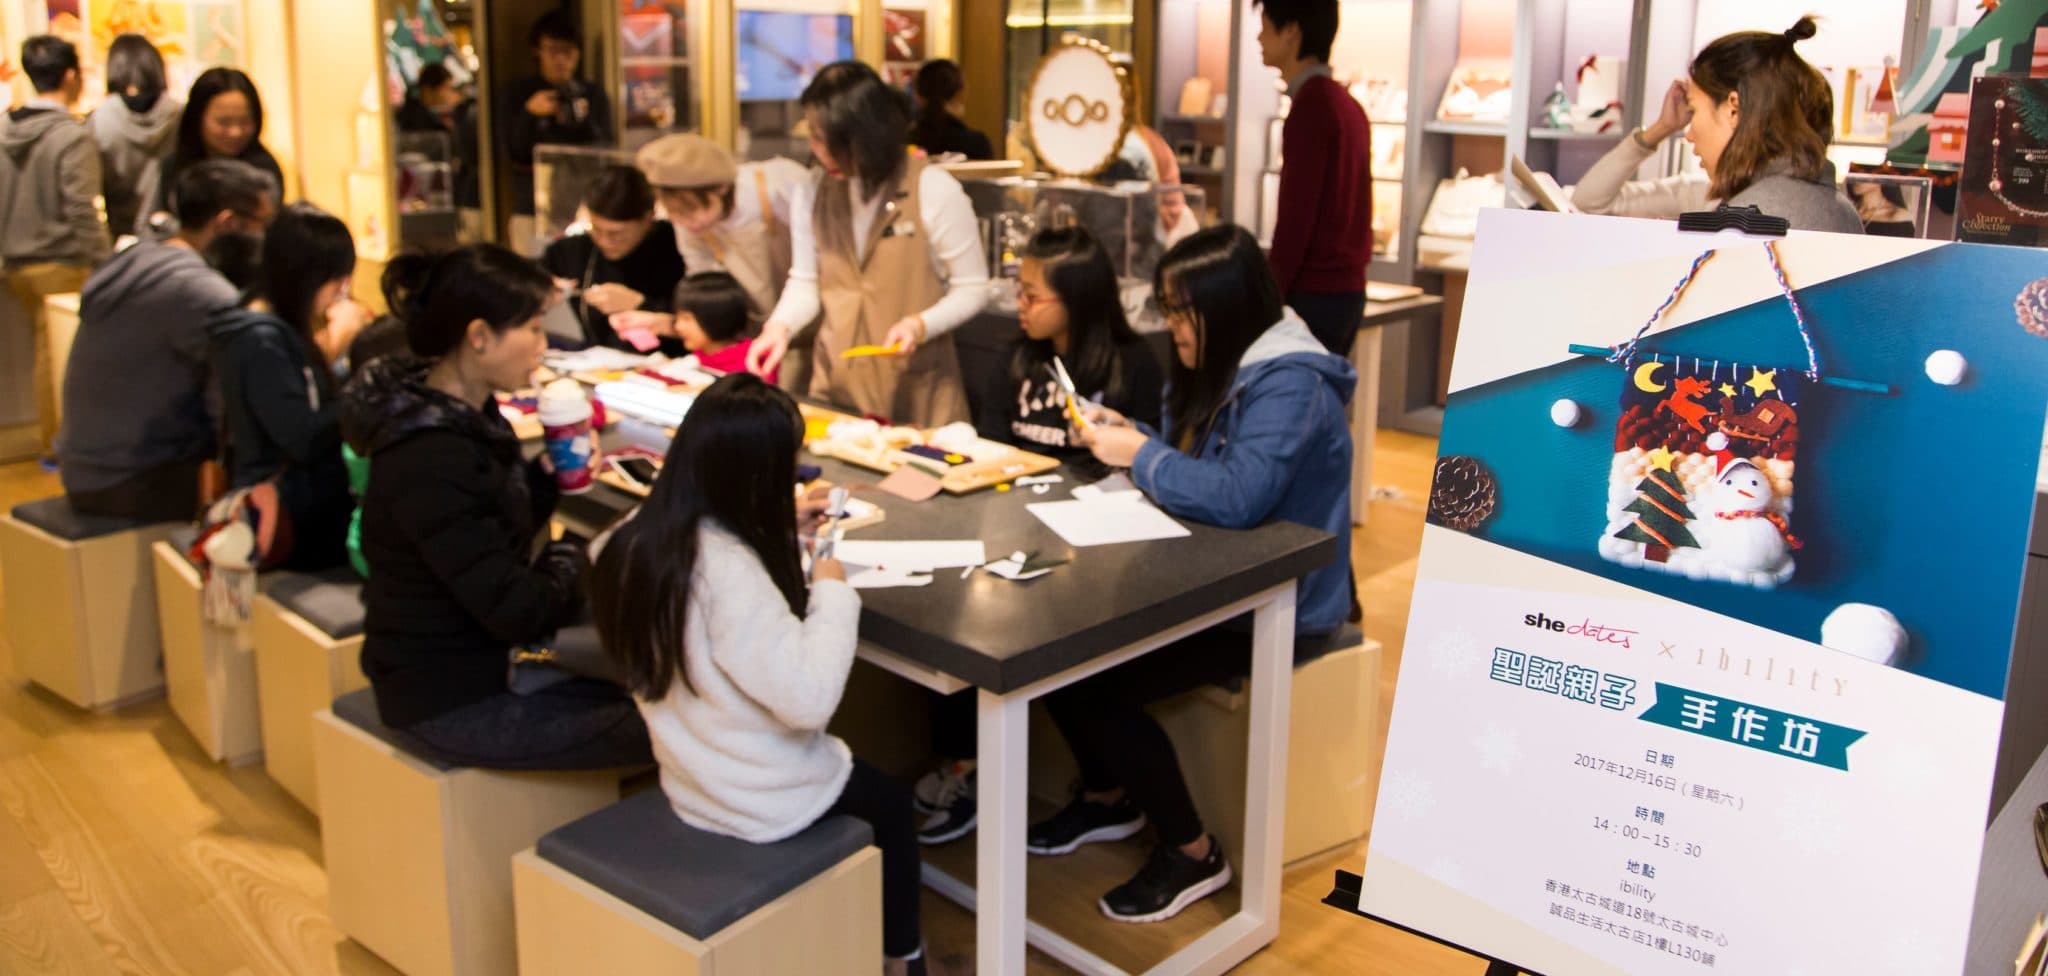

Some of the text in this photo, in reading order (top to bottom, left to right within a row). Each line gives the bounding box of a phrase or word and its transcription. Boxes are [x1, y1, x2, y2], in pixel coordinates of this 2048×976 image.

[1524, 612, 1565, 633] she
[1566, 617, 1640, 649] dates
[1490, 647, 1821, 758] 聖誕親子 手作坊
[1645, 749, 1675, 769] 日期
[1634, 806, 1665, 826] 時間
[1625, 858, 1656, 880] 地點
[1619, 879, 1656, 903] ibility
